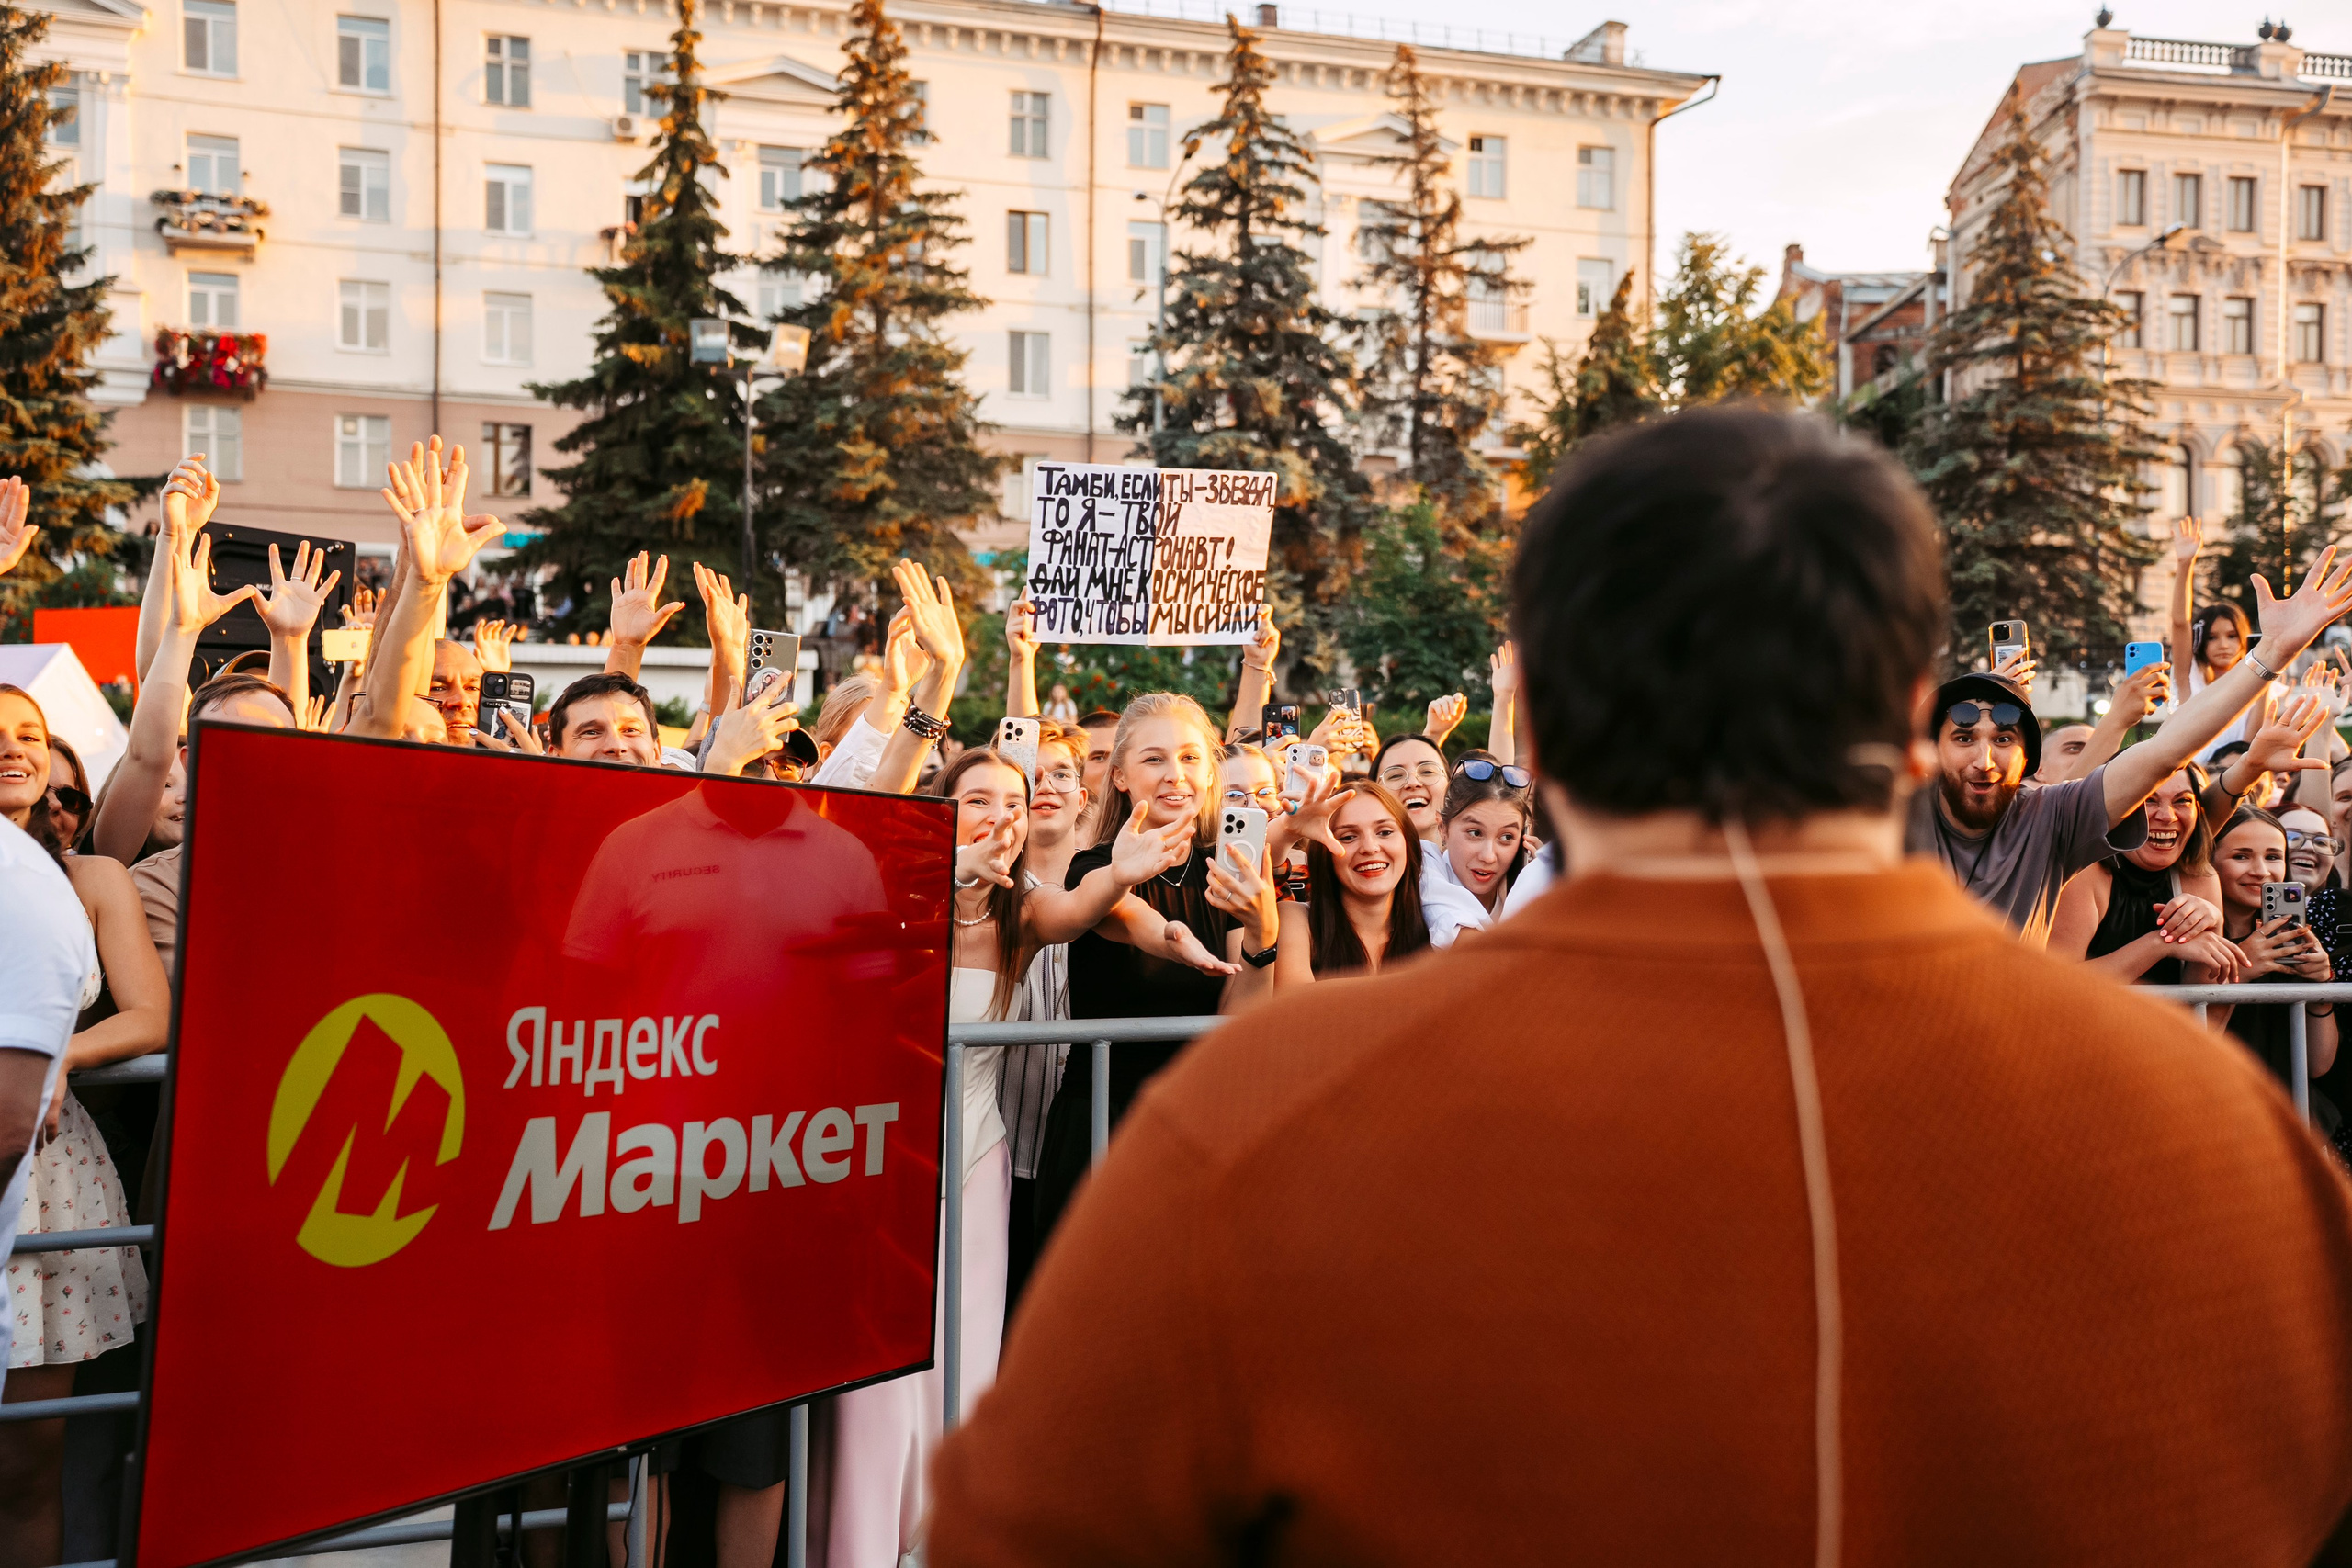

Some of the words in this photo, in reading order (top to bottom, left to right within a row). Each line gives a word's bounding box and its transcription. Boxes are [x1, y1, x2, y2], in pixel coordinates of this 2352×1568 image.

[1120, 473, 1165, 502] ЕСЛИ
[1037, 496, 1070, 529] ТО
[1120, 500, 1182, 536] ТВОЙ
[1083, 566, 1136, 603] МНЕ
[1136, 568, 1266, 604] КОСМИЧЕСКОЕ
[1028, 595, 1083, 637] ФОТО,
[1085, 598, 1149, 636] ЧТОБЫ
[1148, 603, 1192, 636] МЫ
[503, 1005, 720, 1097] Яндекс
[487, 1101, 899, 1232] Маркет
